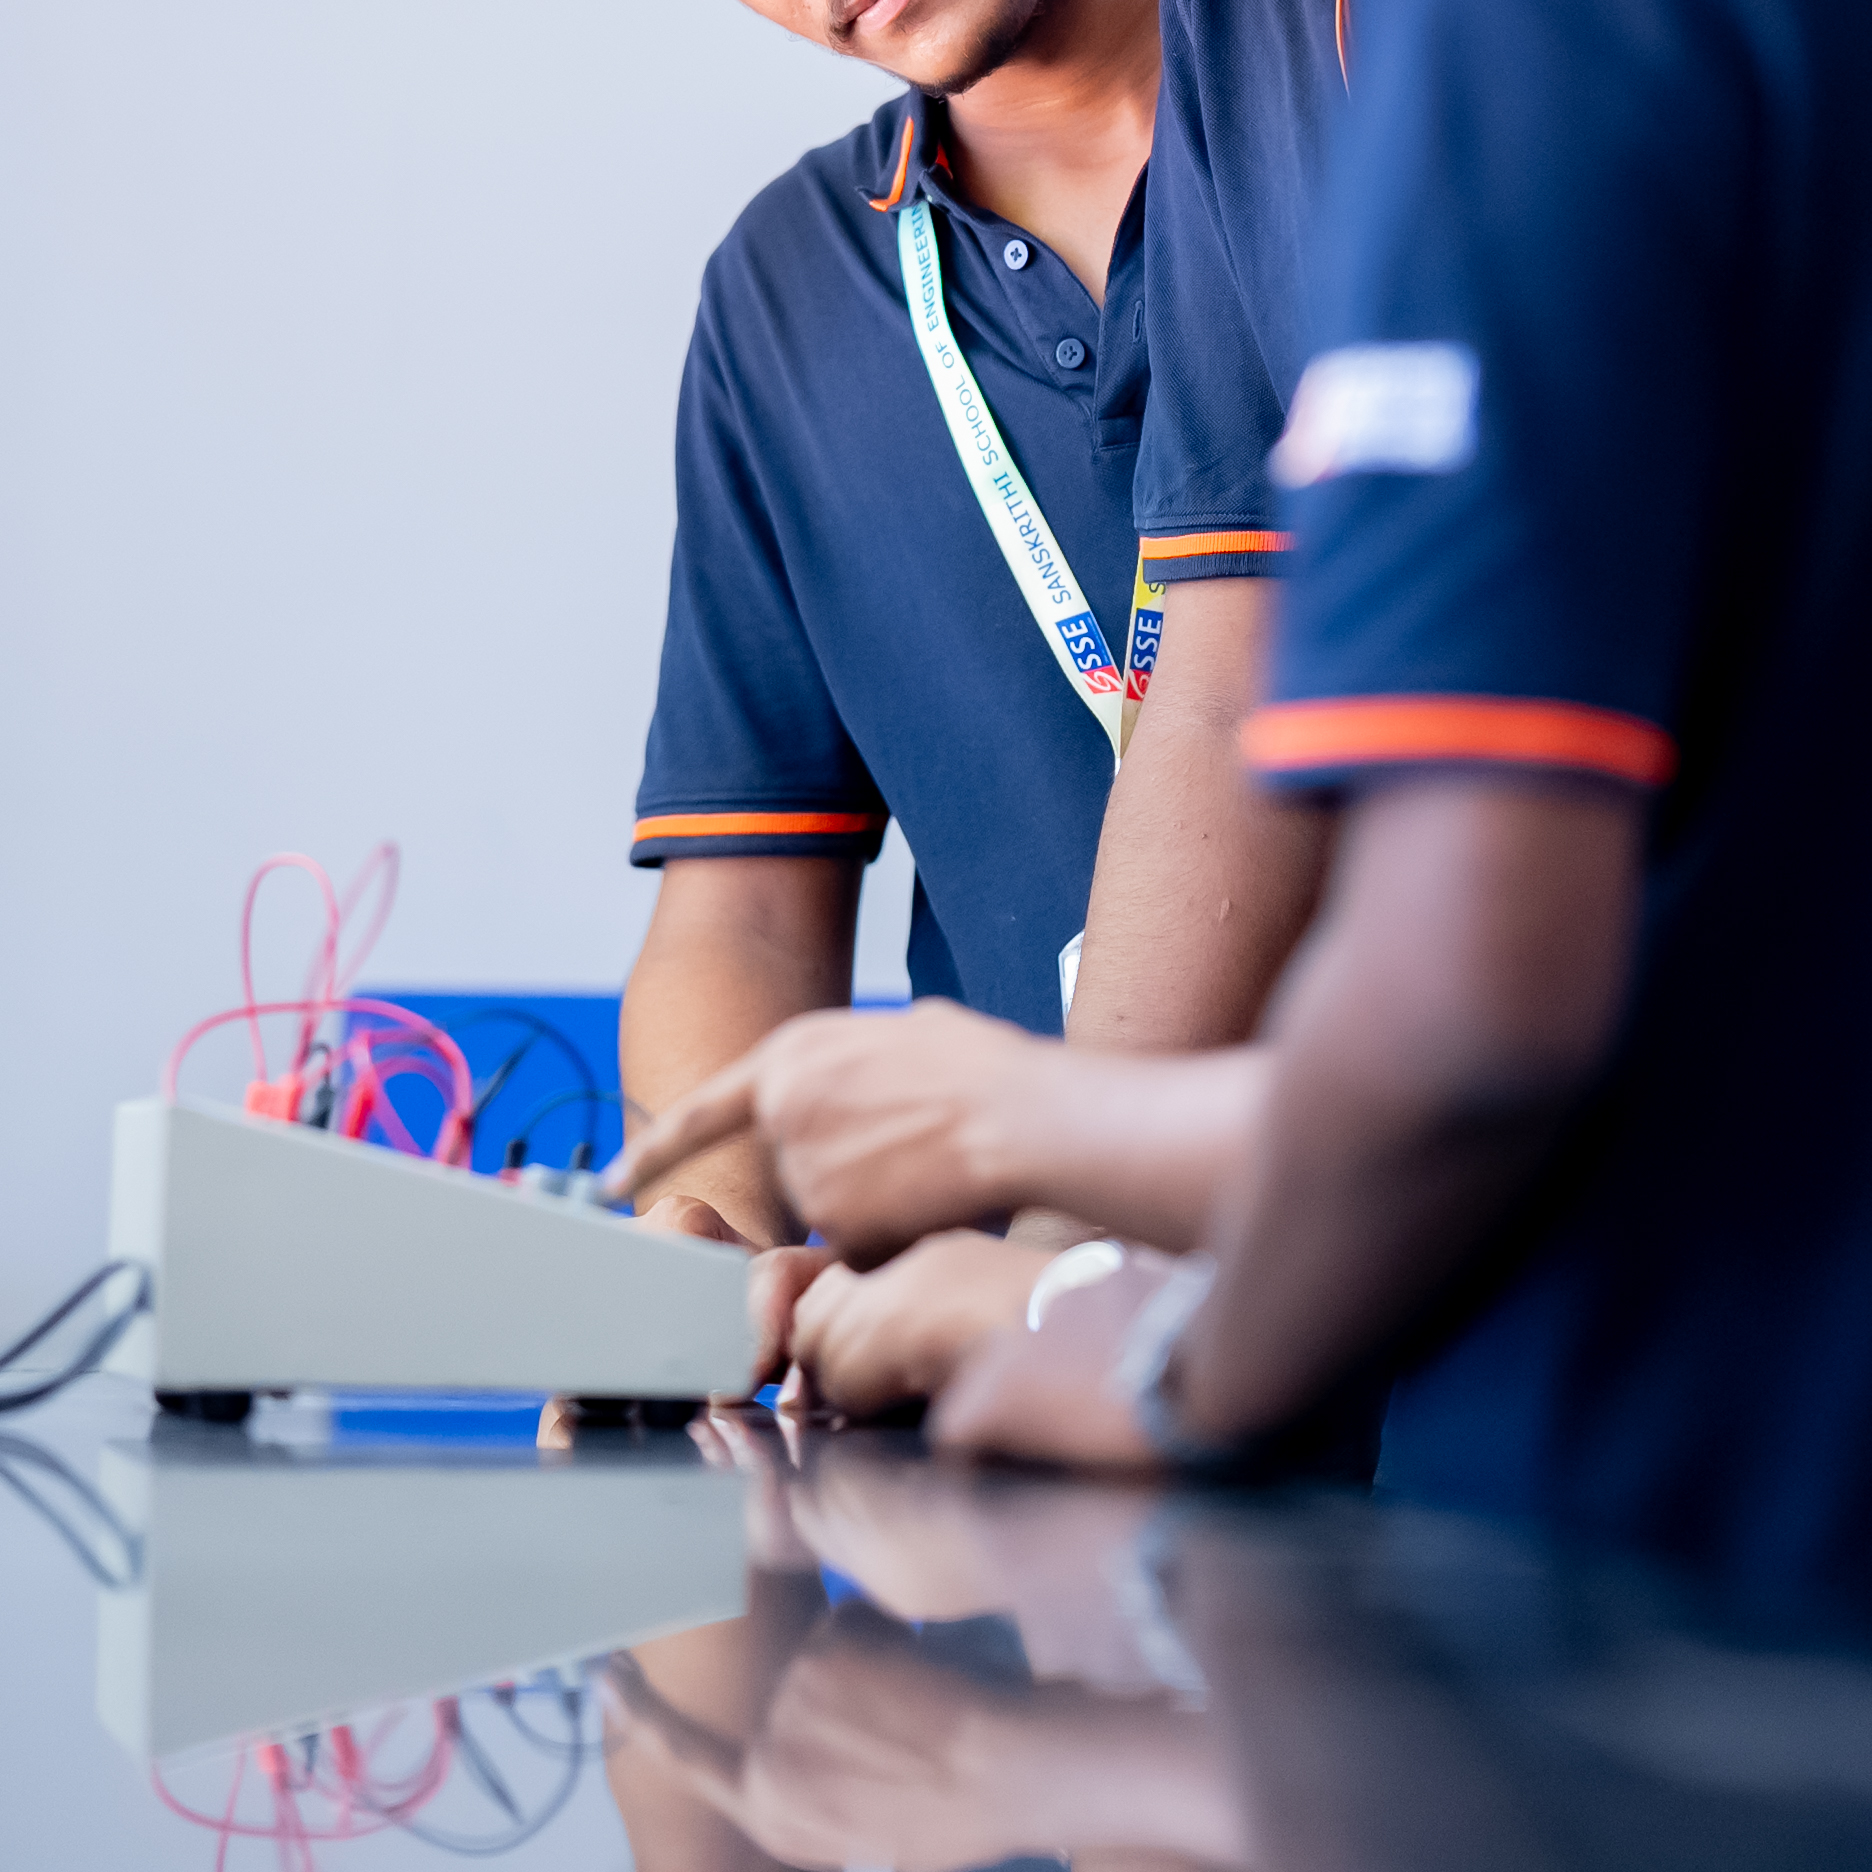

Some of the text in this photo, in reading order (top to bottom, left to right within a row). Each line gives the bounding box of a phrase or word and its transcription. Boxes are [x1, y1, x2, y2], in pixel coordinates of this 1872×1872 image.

[935, 341, 955, 369] OF
[956, 374, 999, 466] SCHOOL
[993, 471, 1072, 604] SANSKRITHI
[1061, 618, 1103, 671] SSE
[1133, 616, 1162, 670] SSE
